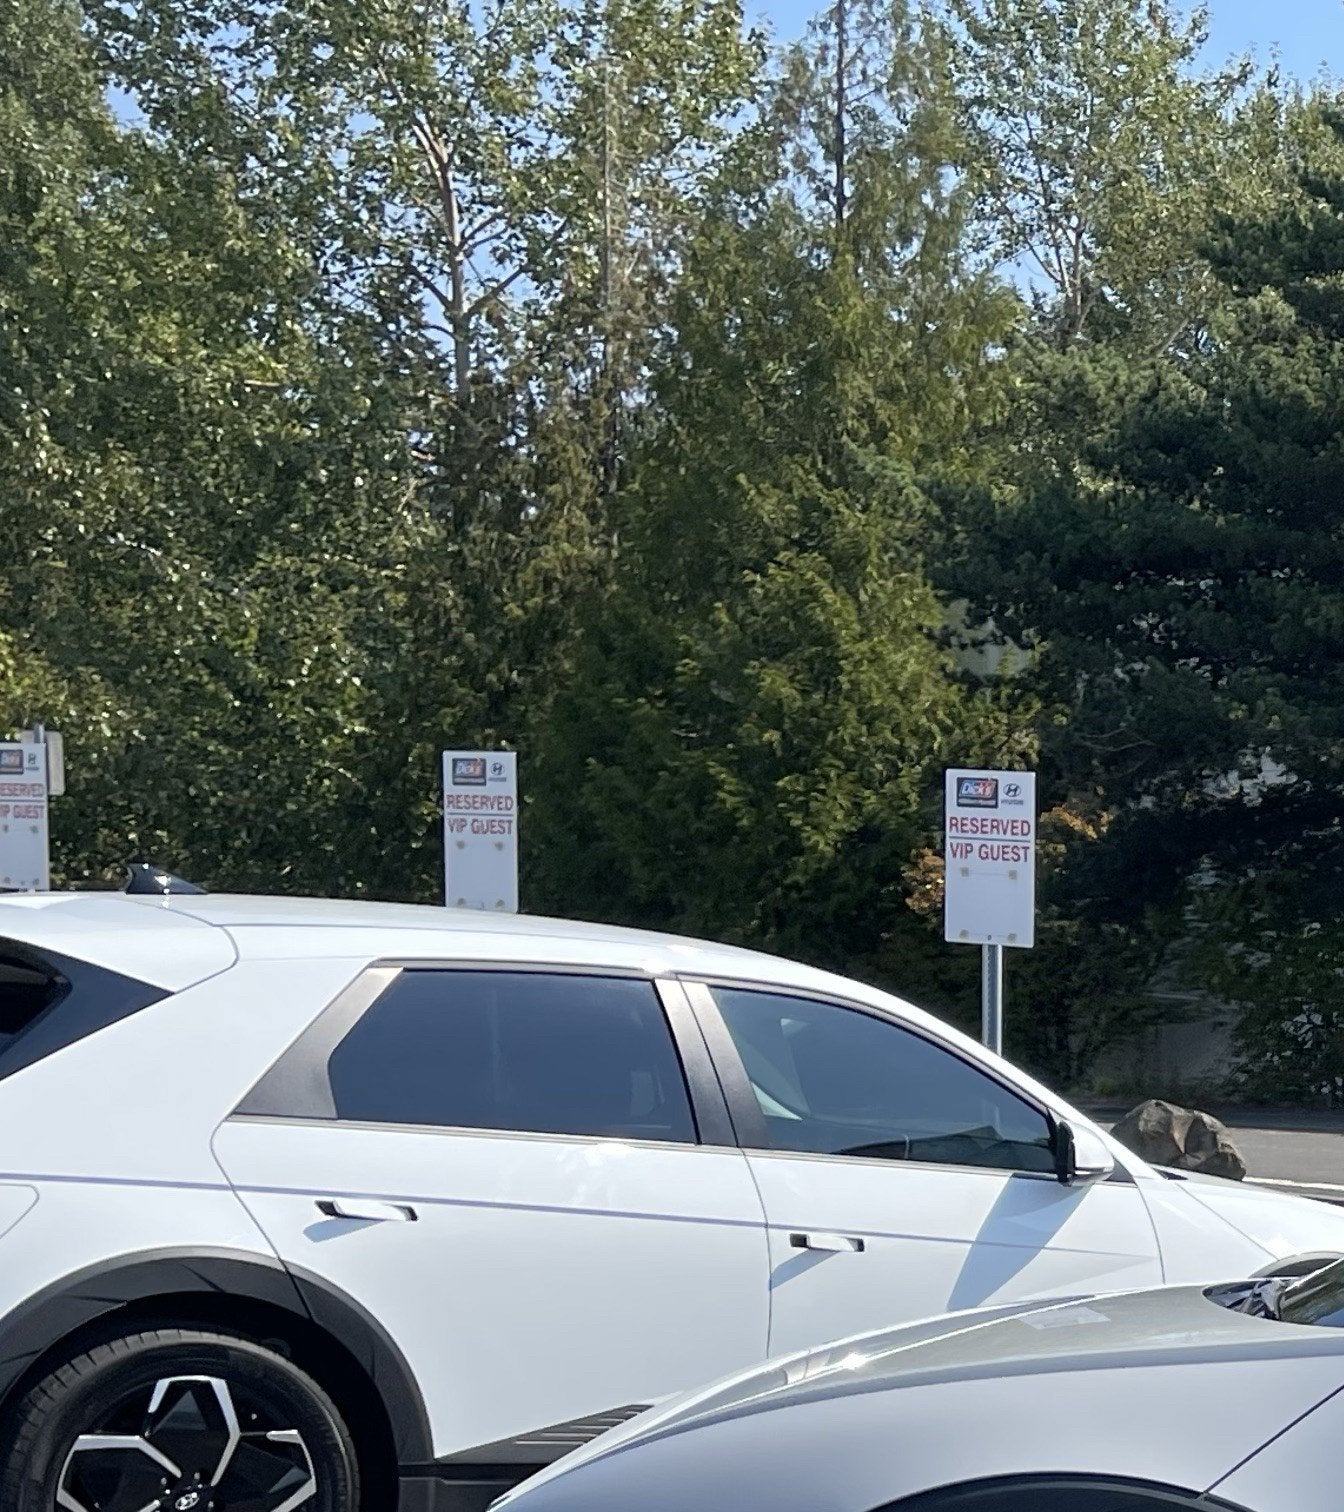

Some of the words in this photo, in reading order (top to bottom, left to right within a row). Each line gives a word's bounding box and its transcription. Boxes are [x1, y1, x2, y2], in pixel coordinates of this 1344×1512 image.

[447, 795, 513, 811] RESERVED
[950, 816, 1031, 836] RESERVED
[949, 842, 974, 859] VIP
[978, 844, 1030, 862] GUEST
